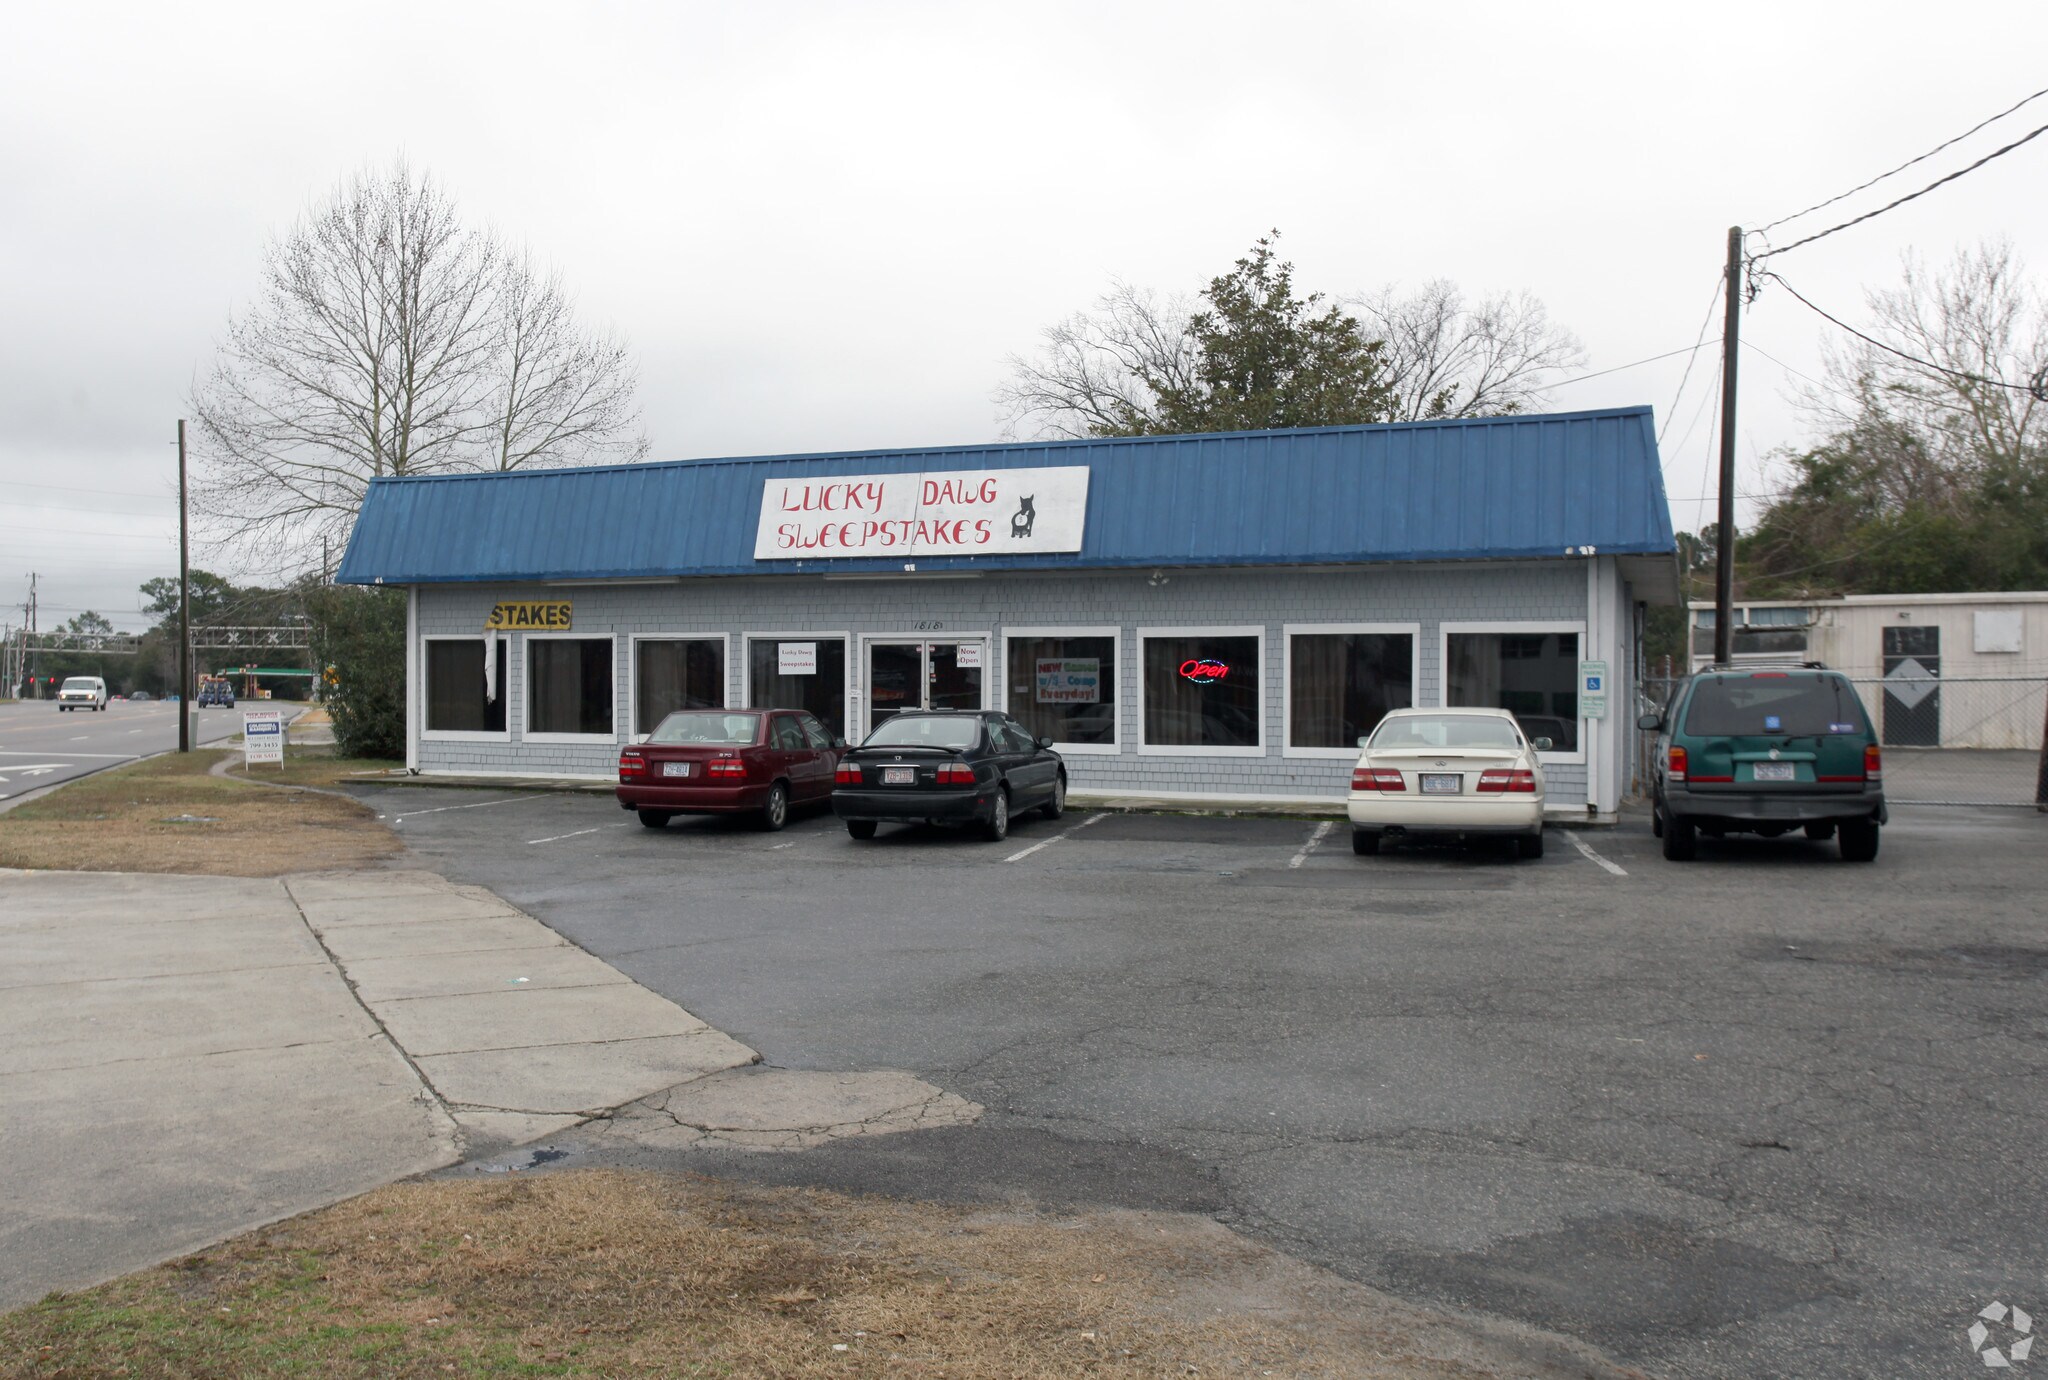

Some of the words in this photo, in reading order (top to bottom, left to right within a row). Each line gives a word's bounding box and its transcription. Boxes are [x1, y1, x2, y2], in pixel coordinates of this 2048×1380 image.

[781, 481, 885, 515] LUCKY
[922, 478, 998, 506] DAWG
[777, 518, 993, 550] SWEEPSTAKES
[489, 604, 571, 626] STAKES
[960, 657, 979, 665] Open
[1038, 662, 1062, 673] NEW
[1179, 659, 1230, 678] Open
[1067, 675, 1097, 687] Comp
[1040, 688, 1095, 701] Everyday!
